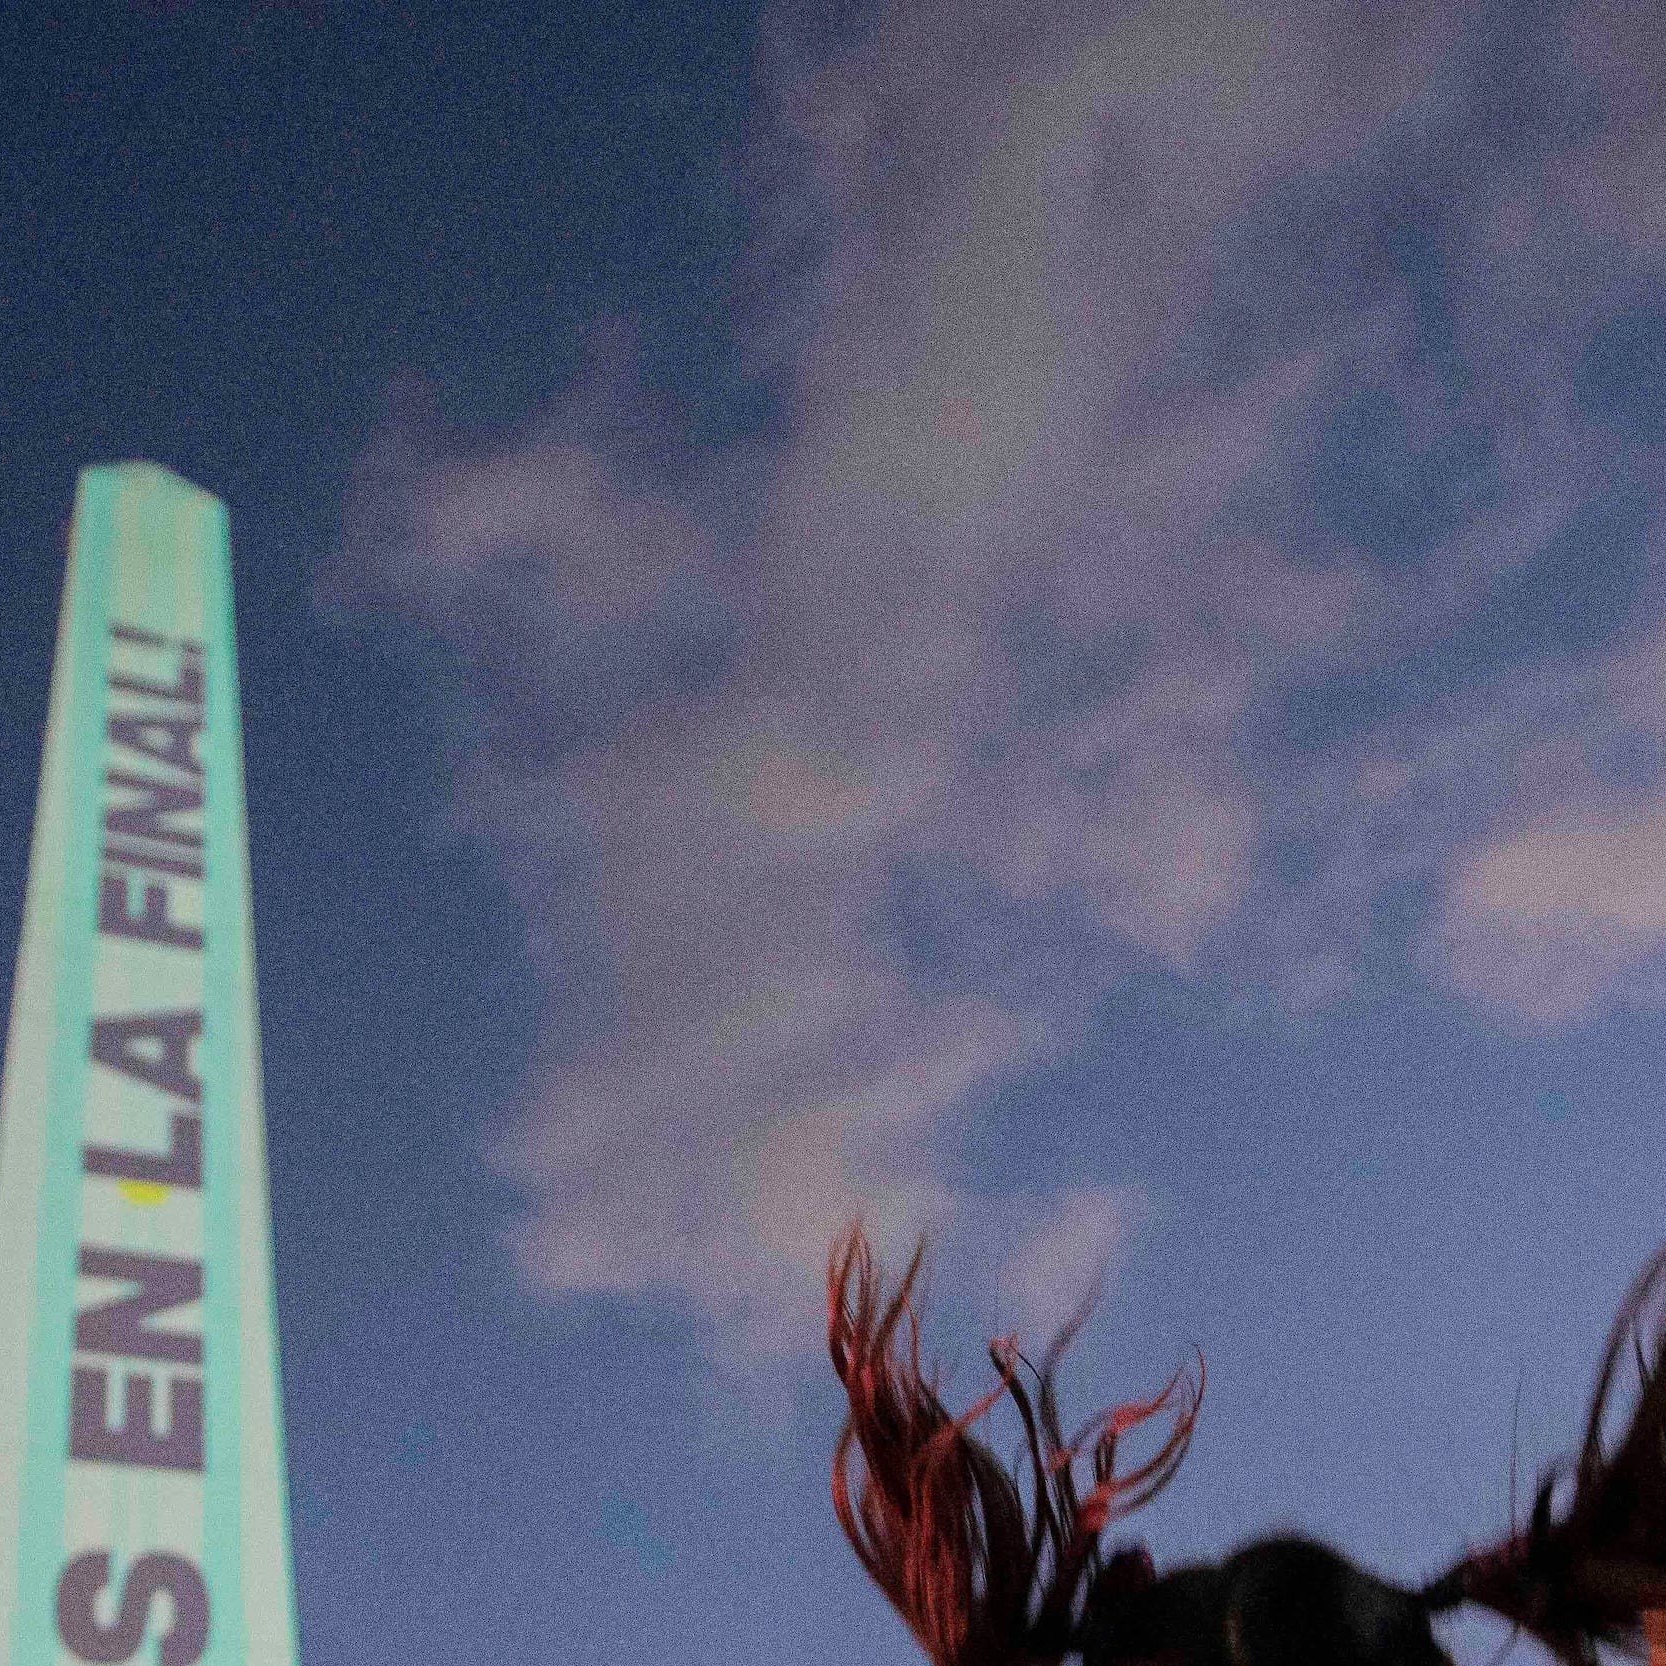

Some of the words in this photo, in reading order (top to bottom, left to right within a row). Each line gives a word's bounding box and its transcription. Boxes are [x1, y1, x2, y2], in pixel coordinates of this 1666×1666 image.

[96, 623, 208, 950] FINAL!
[82, 1007, 204, 1191] LA
[68, 1242, 207, 1474] EN
